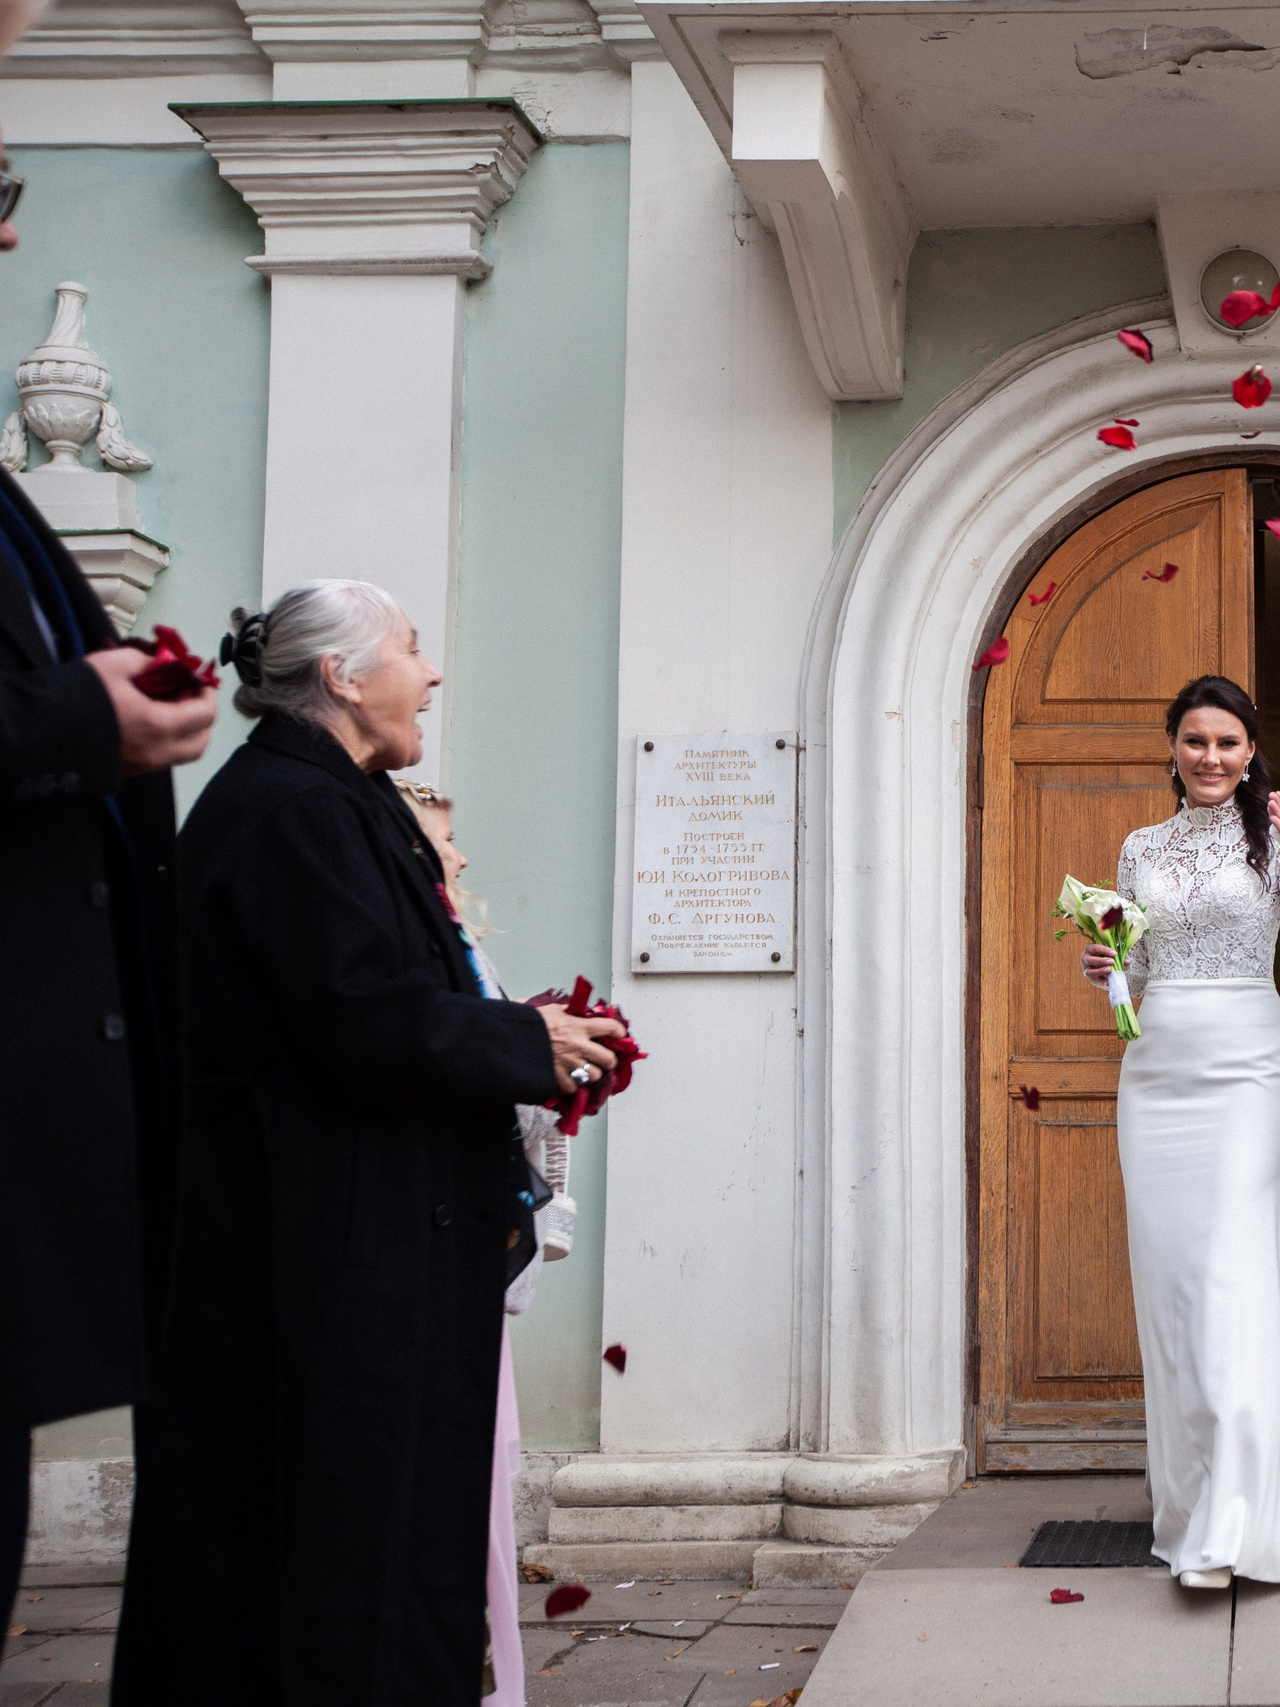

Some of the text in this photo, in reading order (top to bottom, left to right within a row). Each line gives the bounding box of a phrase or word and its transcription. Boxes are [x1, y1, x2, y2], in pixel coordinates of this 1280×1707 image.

[684, 750, 749, 758] ПАМЯТНИК
[674, 761, 756, 770] АРХИТЕКТУРЫ
[685, 772, 751, 782] XVIII ВЕКА
[655, 790, 775, 807] ИТАЛЬЯНСКИЙ
[688, 811, 743, 821] ДОМИК
[683, 832, 744, 841] ПОСТРОЕН
[672, 856, 755, 865] ПРИ УЧАСТИИ
[673, 870, 790, 883] КОЛОГРИВОВА
[679, 888, 761, 897] КРЕПОСТНОГО
[674, 900, 751, 908] АРХИТЕКТОРА
[692, 913, 775, 924] АРГУНОВА
